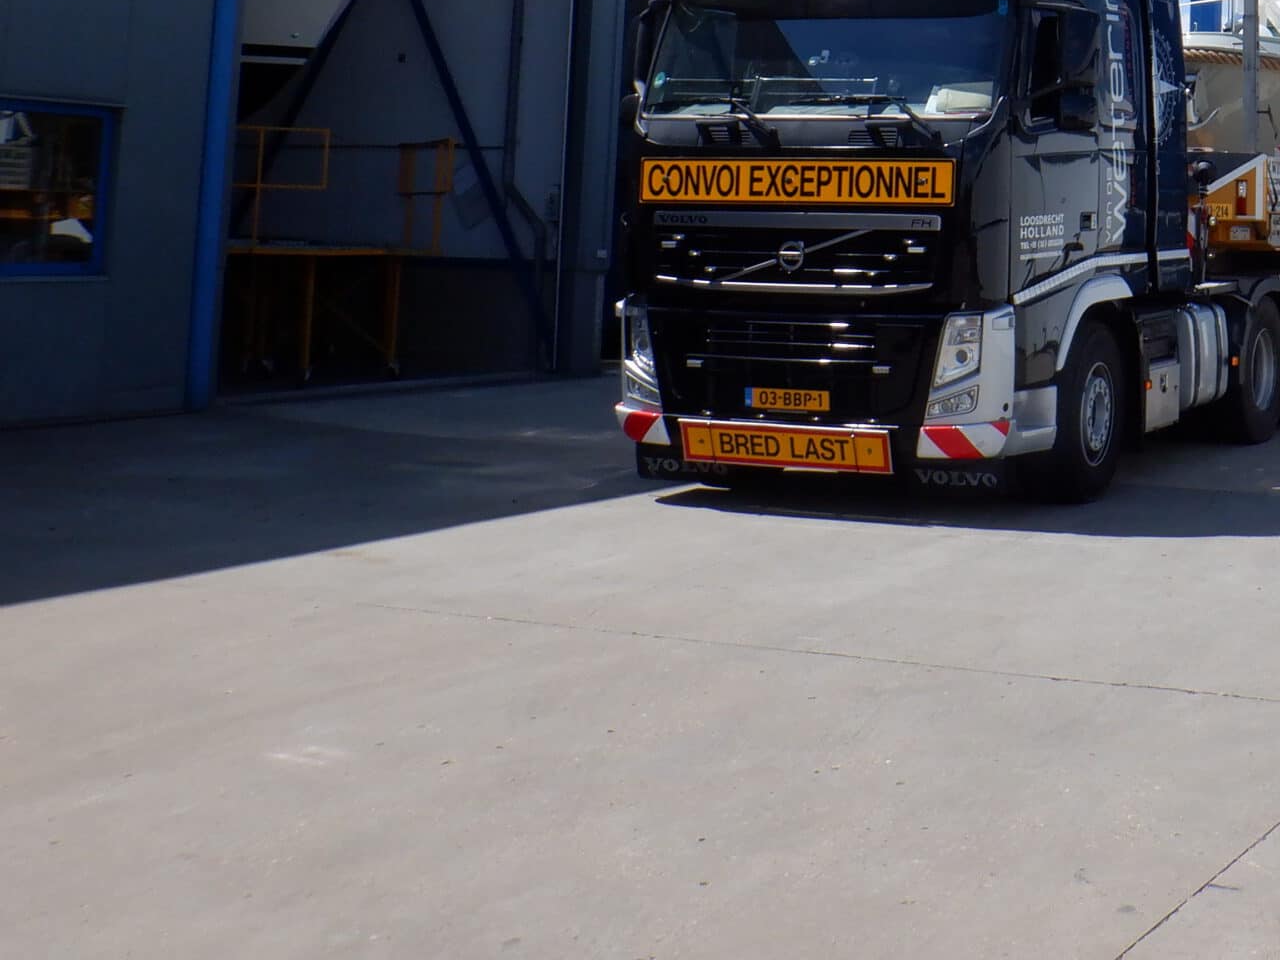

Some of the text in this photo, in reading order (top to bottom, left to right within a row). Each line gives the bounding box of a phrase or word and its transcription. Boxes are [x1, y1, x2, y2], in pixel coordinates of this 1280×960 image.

[650, 164, 946, 199] CONVOI EXCEPTIONNEL
[658, 214, 708, 224] VOLVO
[911, 218, 933, 228] FH
[1020, 214, 1065, 227] LOOSDRECHT
[1020, 225, 1065, 239] HOLLAND
[758, 389, 824, 407] 03-BBP-1
[718, 432, 849, 462] BRED LAST
[914, 468, 998, 489] VOLVO
